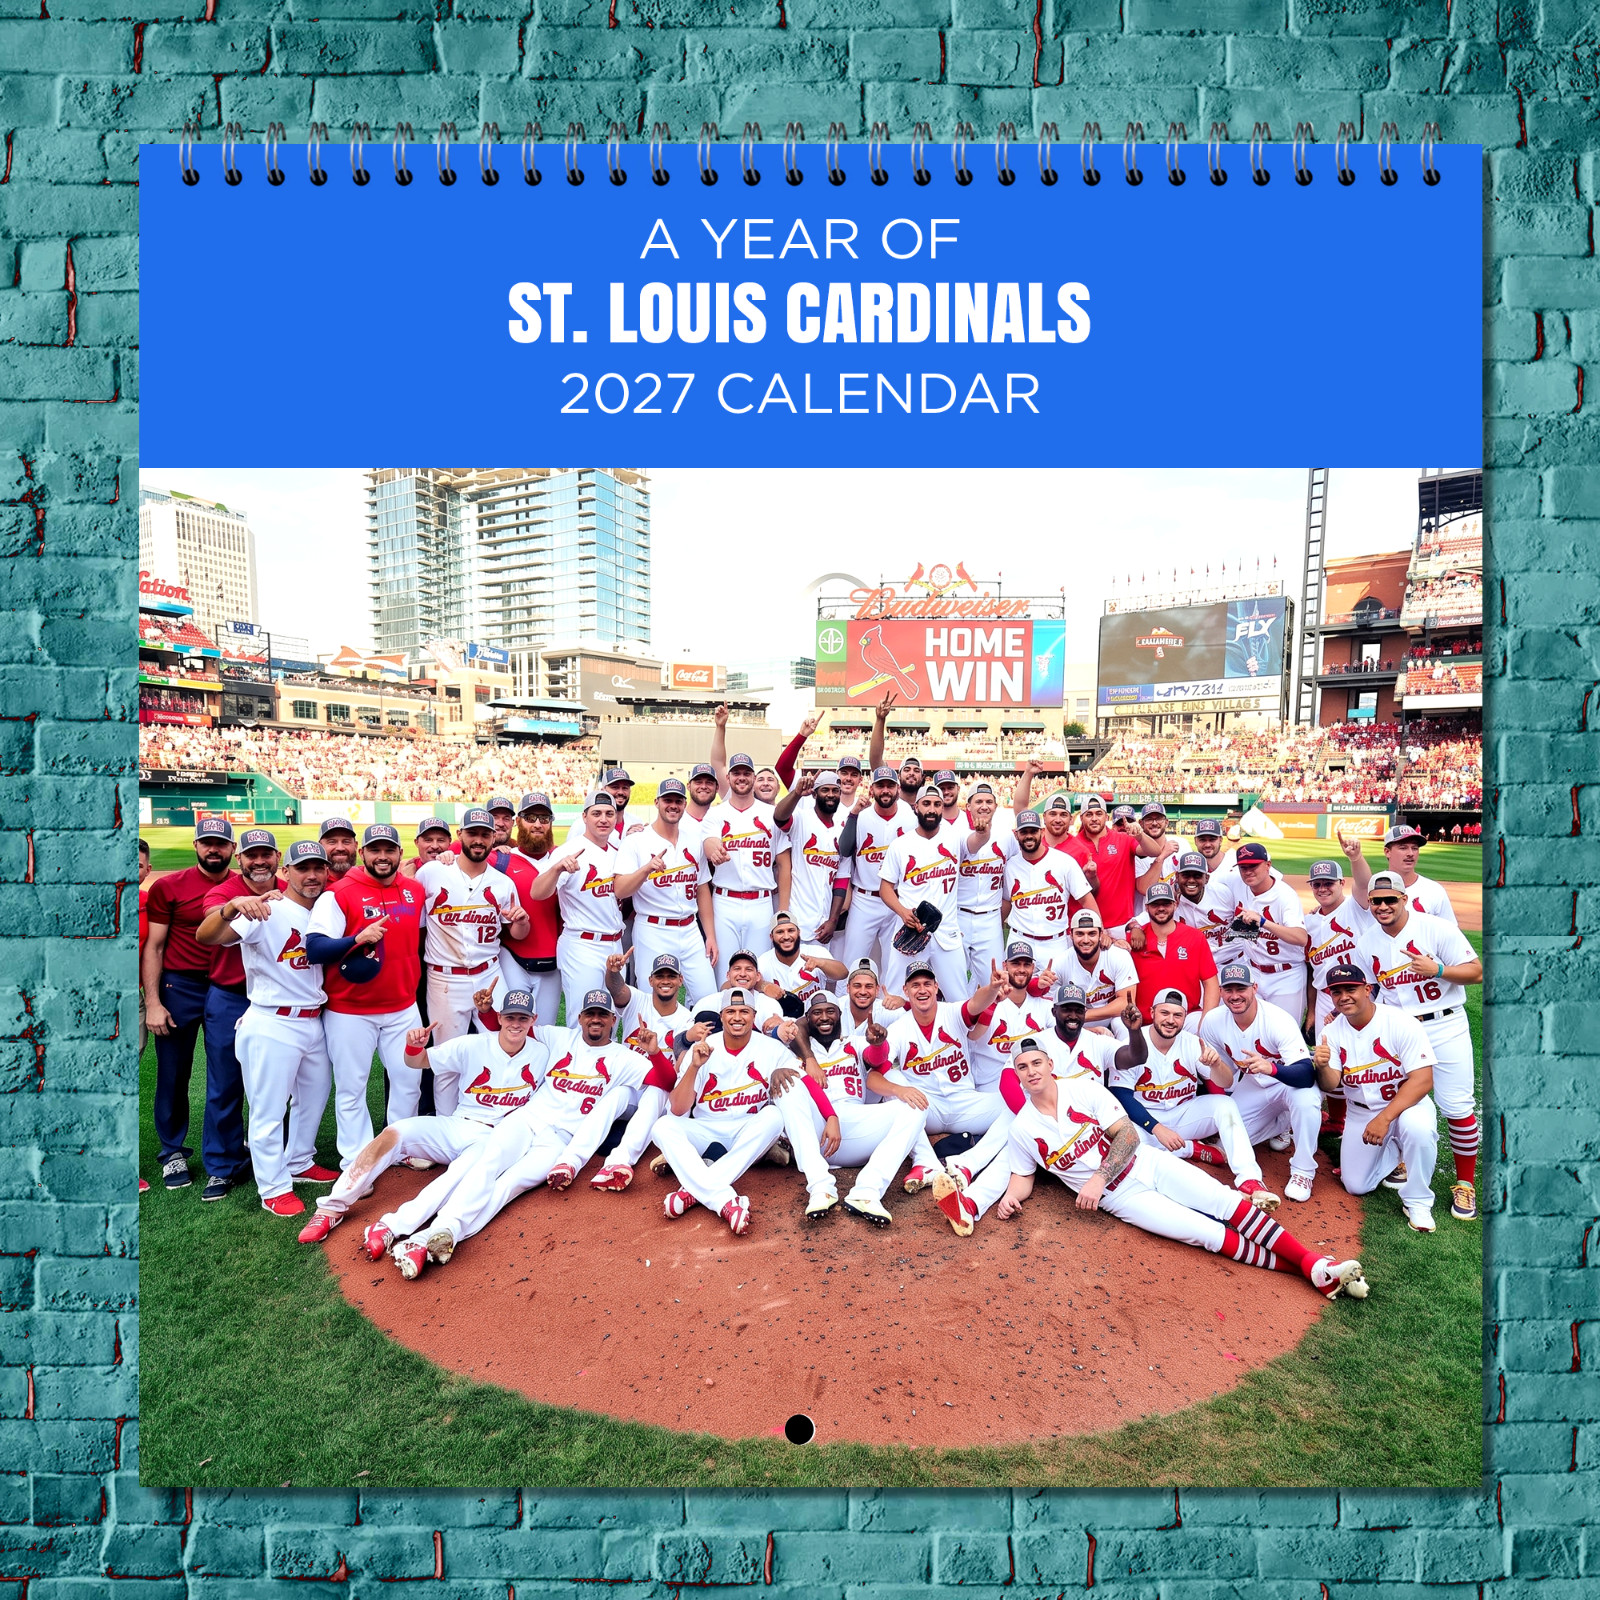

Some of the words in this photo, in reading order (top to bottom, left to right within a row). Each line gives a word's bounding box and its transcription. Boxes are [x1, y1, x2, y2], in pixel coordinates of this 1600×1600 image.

[640, 218, 679, 259] A
[701, 218, 858, 259] YEAR
[882, 218, 960, 259] OF
[508, 282, 588, 343] ST.
[609, 282, 766, 343] LOUIS
[787, 282, 1091, 343] CARDINALS
[561, 373, 694, 413] 2027
[718, 373, 1040, 413] CALENDAR
[139, 571, 192, 601] ation
[850, 587, 1030, 620] Budweiser
[925, 627, 1025, 657] HOME
[925, 660, 1024, 702] WIN
[722, 835, 770, 851] Cardinals
[653, 870, 698, 888] Cardinal
[911, 862, 957, 886] Cardinals
[942, 877, 957, 894] 17
[1015, 892, 1063, 909] Cardinals
[438, 905, 498, 926] Cardinals
[1045, 904, 1066, 921] 37
[476, 926, 498, 944] 12
[1265, 940, 1280, 955] 8
[1310, 940, 1356, 965] Cardinals
[1337, 952, 1352, 966] 11
[1414, 981, 1442, 1004] 16
[912, 1050, 964, 1075] Cardinals
[947, 1058, 969, 1083] 69
[552, 1072, 604, 1096] Cardinals
[1343, 1067, 1404, 1088] Cardinals
[708, 1089, 769, 1112] Cardinals
[1141, 1083, 1197, 1103] Cardinals
[579, 1097, 596, 1114] 6
[1054, 1126, 1105, 1170] Cardinals
